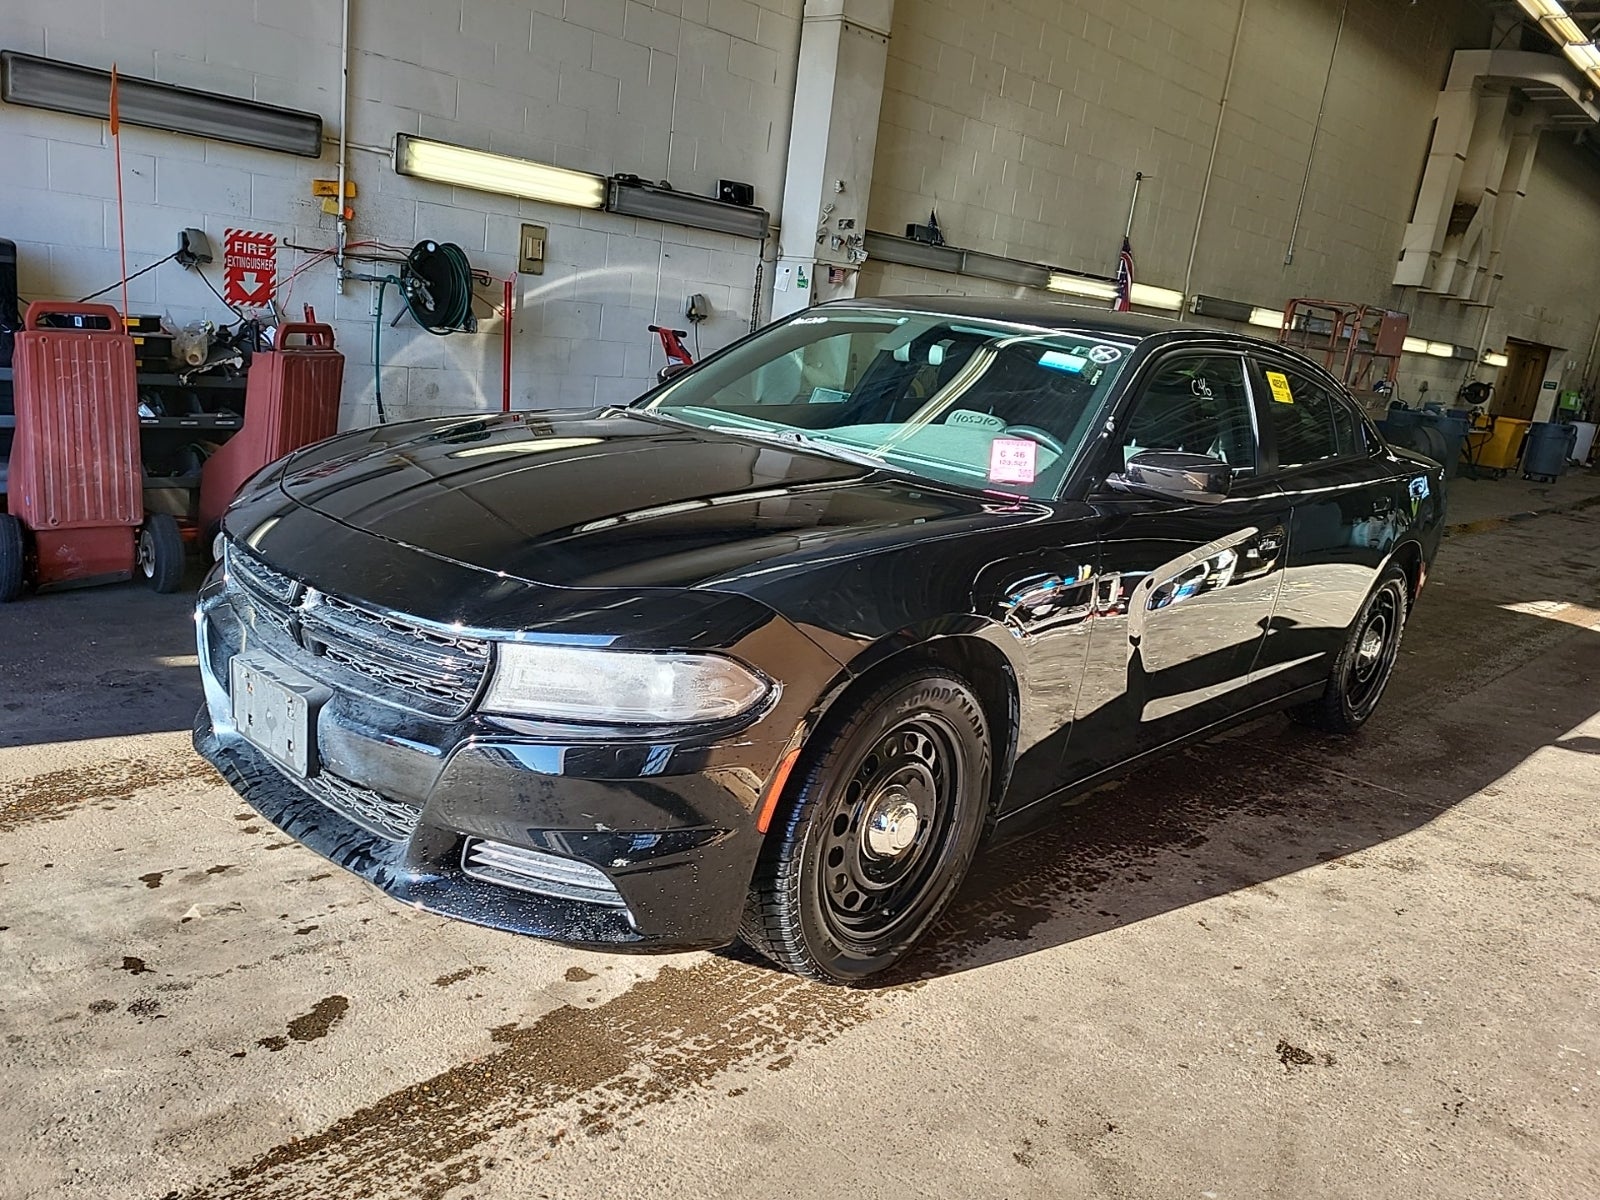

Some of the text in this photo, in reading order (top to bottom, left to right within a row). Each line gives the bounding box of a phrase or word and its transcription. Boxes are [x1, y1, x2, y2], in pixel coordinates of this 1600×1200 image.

[234, 241, 267, 256] FIRE
[227, 255, 274, 271] EXTINGUISHER
[953, 412, 998, 426] 405210
[1000, 450, 1006, 458] C
